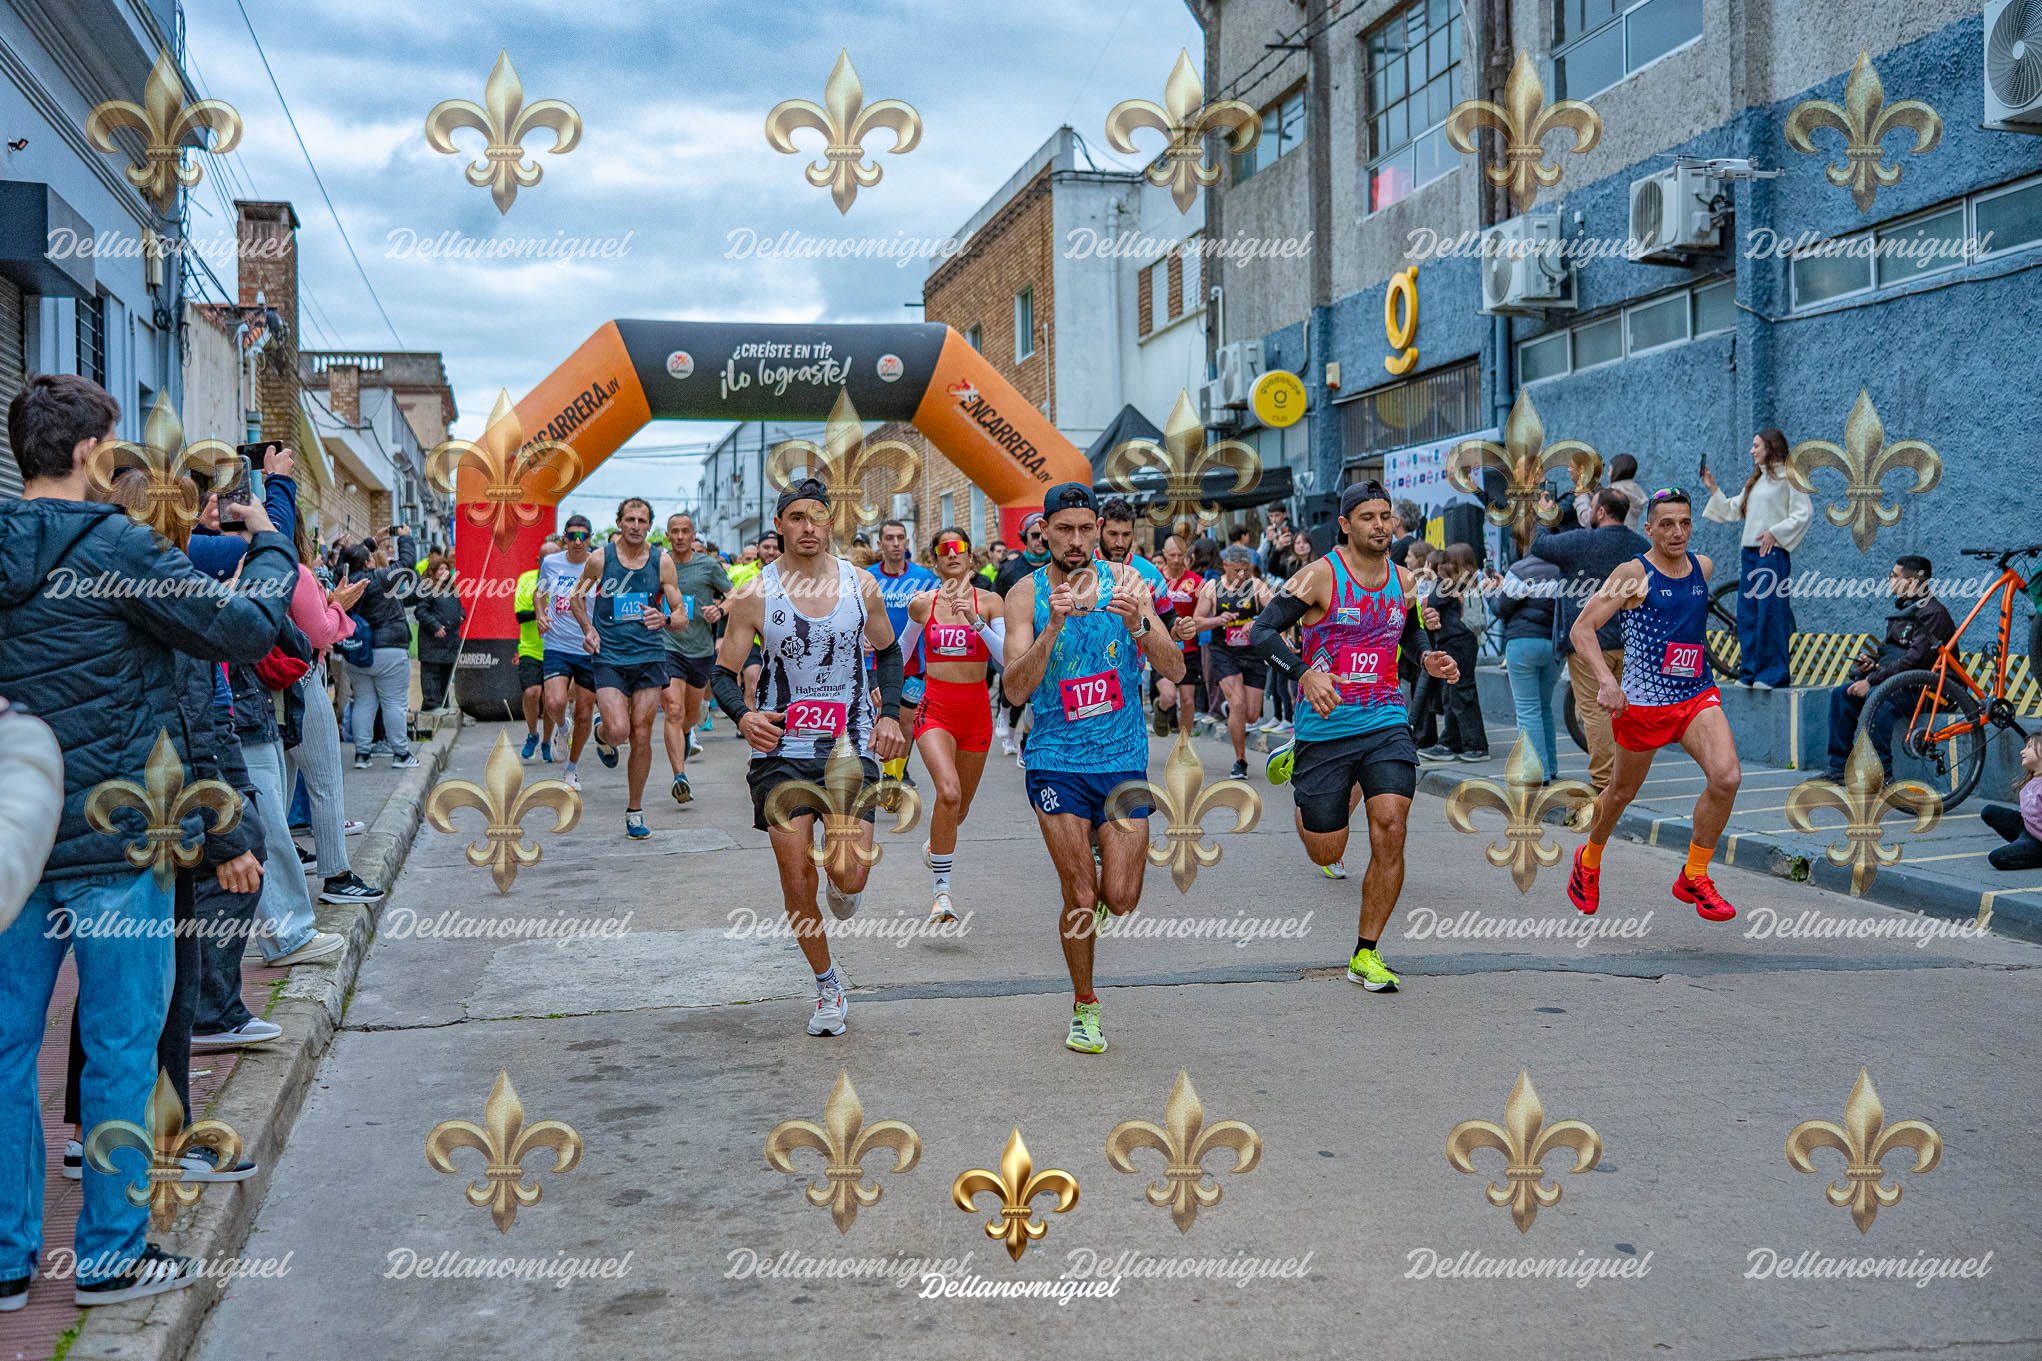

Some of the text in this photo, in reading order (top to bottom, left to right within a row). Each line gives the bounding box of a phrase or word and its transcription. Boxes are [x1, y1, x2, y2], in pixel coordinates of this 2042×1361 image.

[733, 340, 833, 360] ¿CREÍSTE EN TÍ?
[758, 356, 852, 397] lograste!
[621, 600, 642, 614] 413
[938, 629, 967, 647] 178
[1270, 654, 1291, 671] KIPRUN
[1350, 652, 1379, 673] 199
[1670, 648, 1698, 667] 207
[1073, 679, 1108, 707] 179
[795, 705, 837, 731] 234
